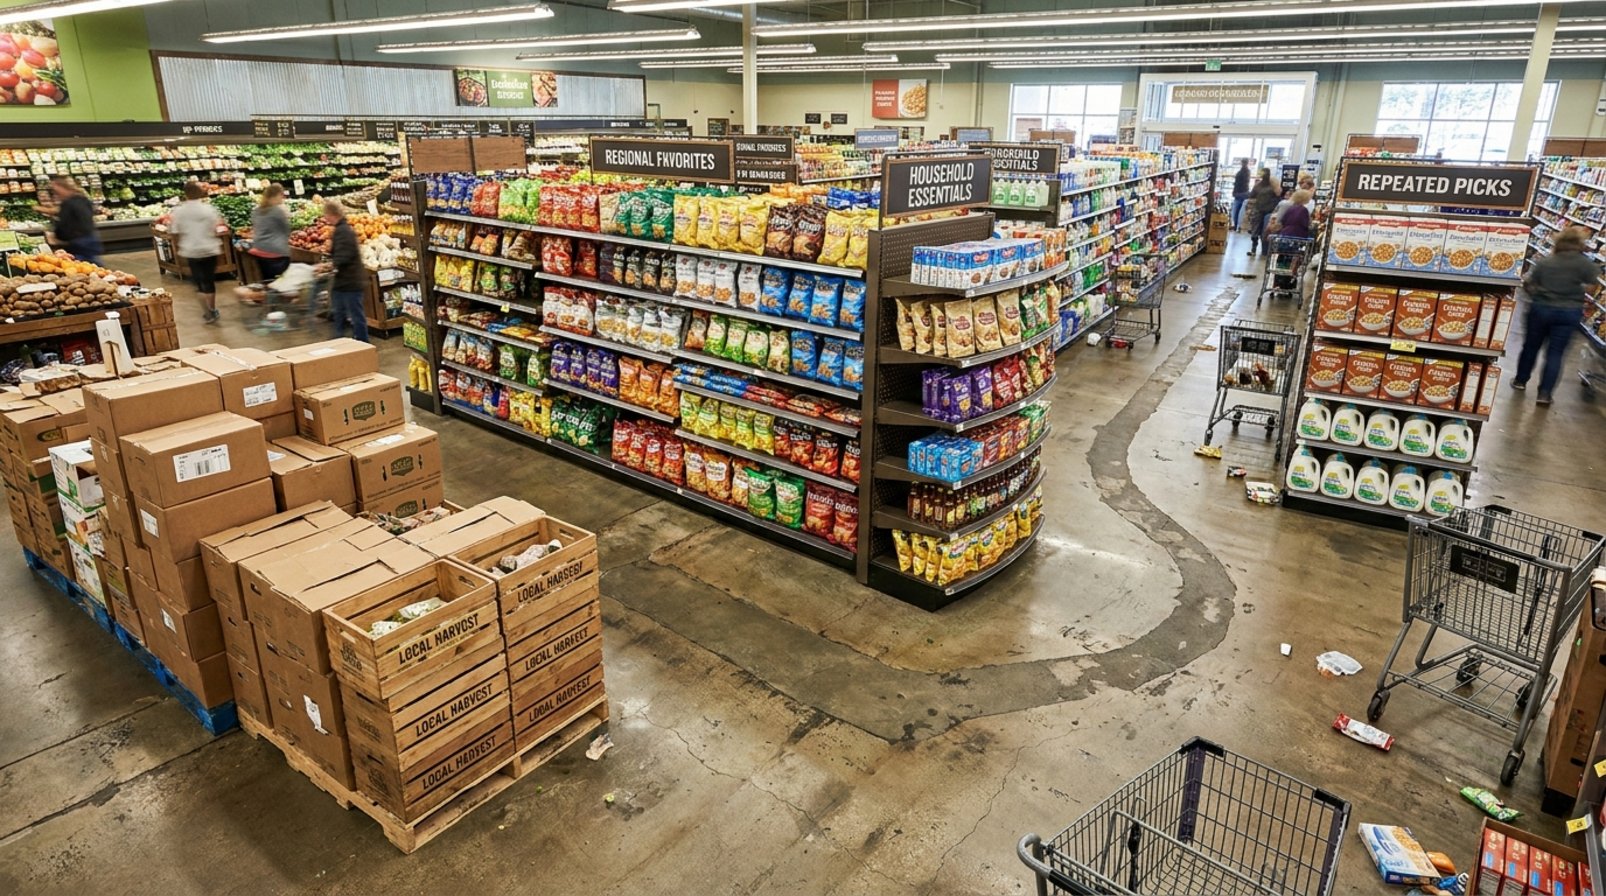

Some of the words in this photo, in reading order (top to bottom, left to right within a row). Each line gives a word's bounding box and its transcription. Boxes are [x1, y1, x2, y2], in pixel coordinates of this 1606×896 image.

[605, 149, 655, 167] REGIONAL
[909, 162, 975, 186] HOUSEHOLD
[1357, 173, 1450, 194] REPEATED
[1453, 177, 1513, 197] PICKS
[907, 183, 973, 208] ESSENTIALS
